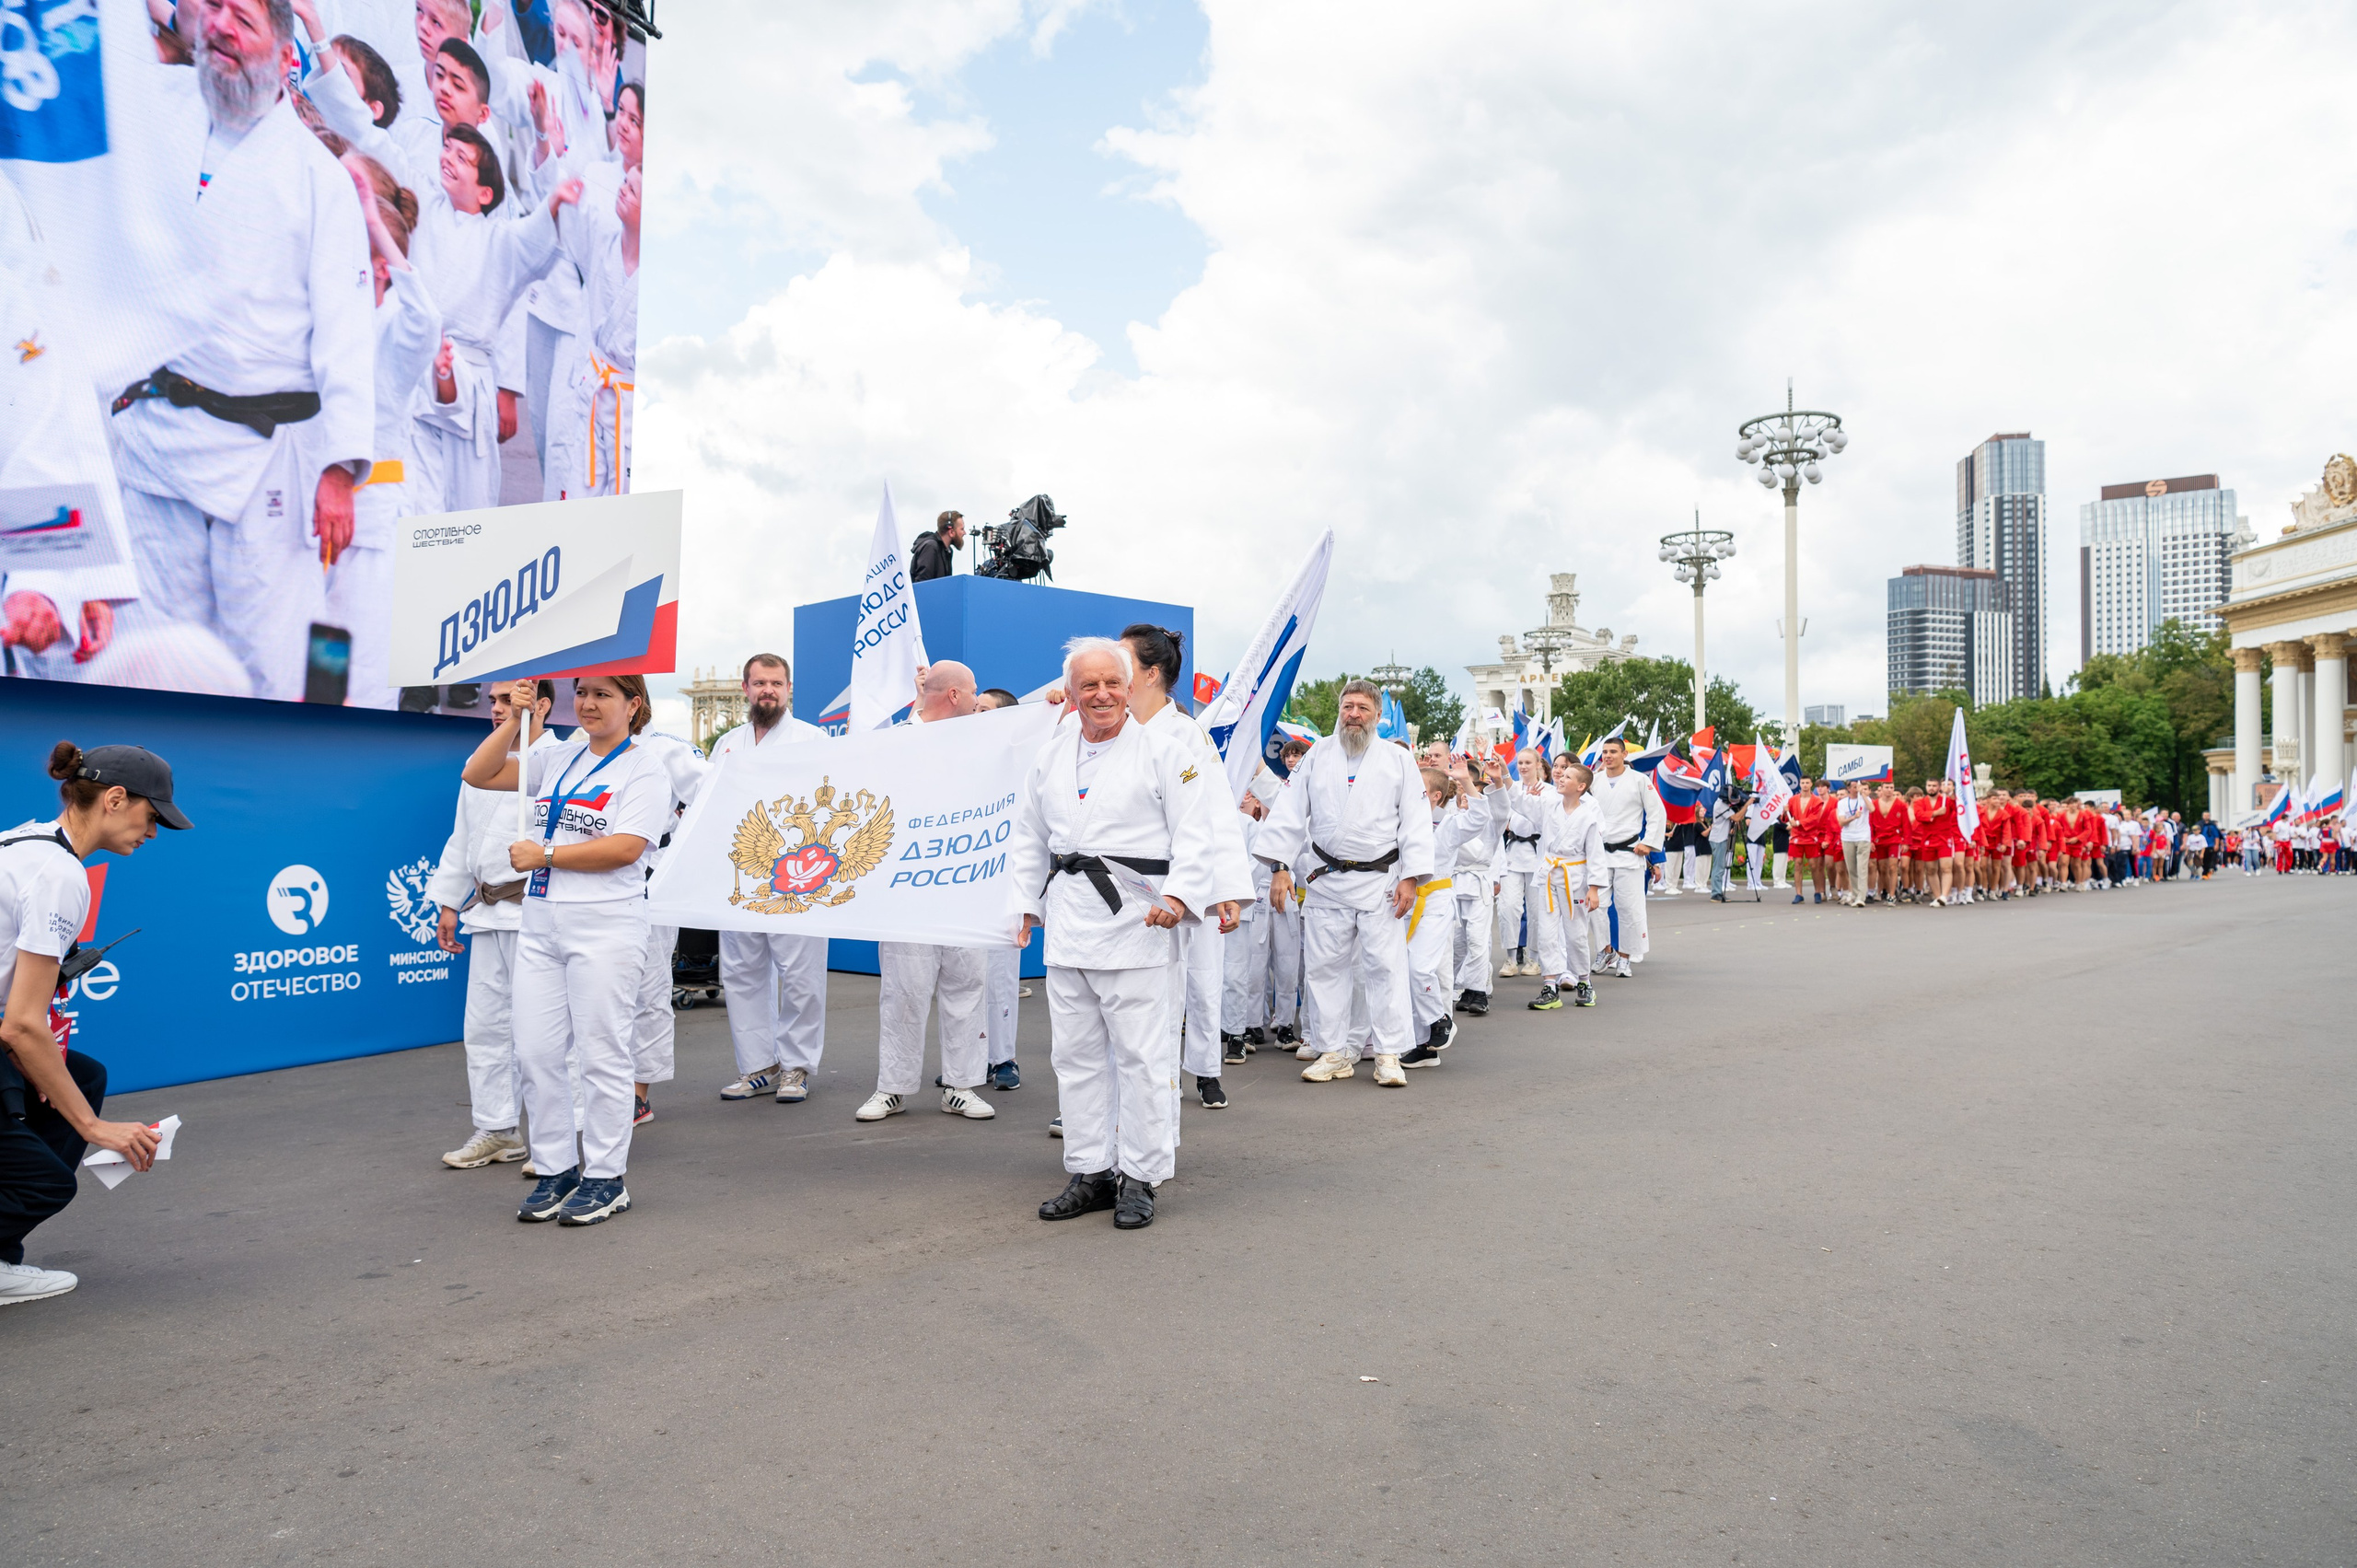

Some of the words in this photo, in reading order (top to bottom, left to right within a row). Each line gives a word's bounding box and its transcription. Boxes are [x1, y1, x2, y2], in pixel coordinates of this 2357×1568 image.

[412, 538, 464, 548] ШЕСТВИЕ
[433, 545, 561, 680] ДЗЮДО
[853, 603, 908, 658] РОССИ
[1519, 673, 1558, 684] АРМЕ
[1838, 756, 1864, 777] САМБО
[908, 793, 1016, 829] ФЕДЕРАЦИЯ
[535, 819, 593, 836] ШЕТВИЕ
[899, 819, 1011, 861] ДЗЮДО
[889, 853, 1006, 889] РОССИИ
[233, 944, 359, 975] ЗДОРОВОЕ
[389, 949, 455, 967] МИНСПОРТ
[231, 971, 362, 1003] ОТЕЧЕСТВО
[398, 968, 449, 985] РОССИИ
